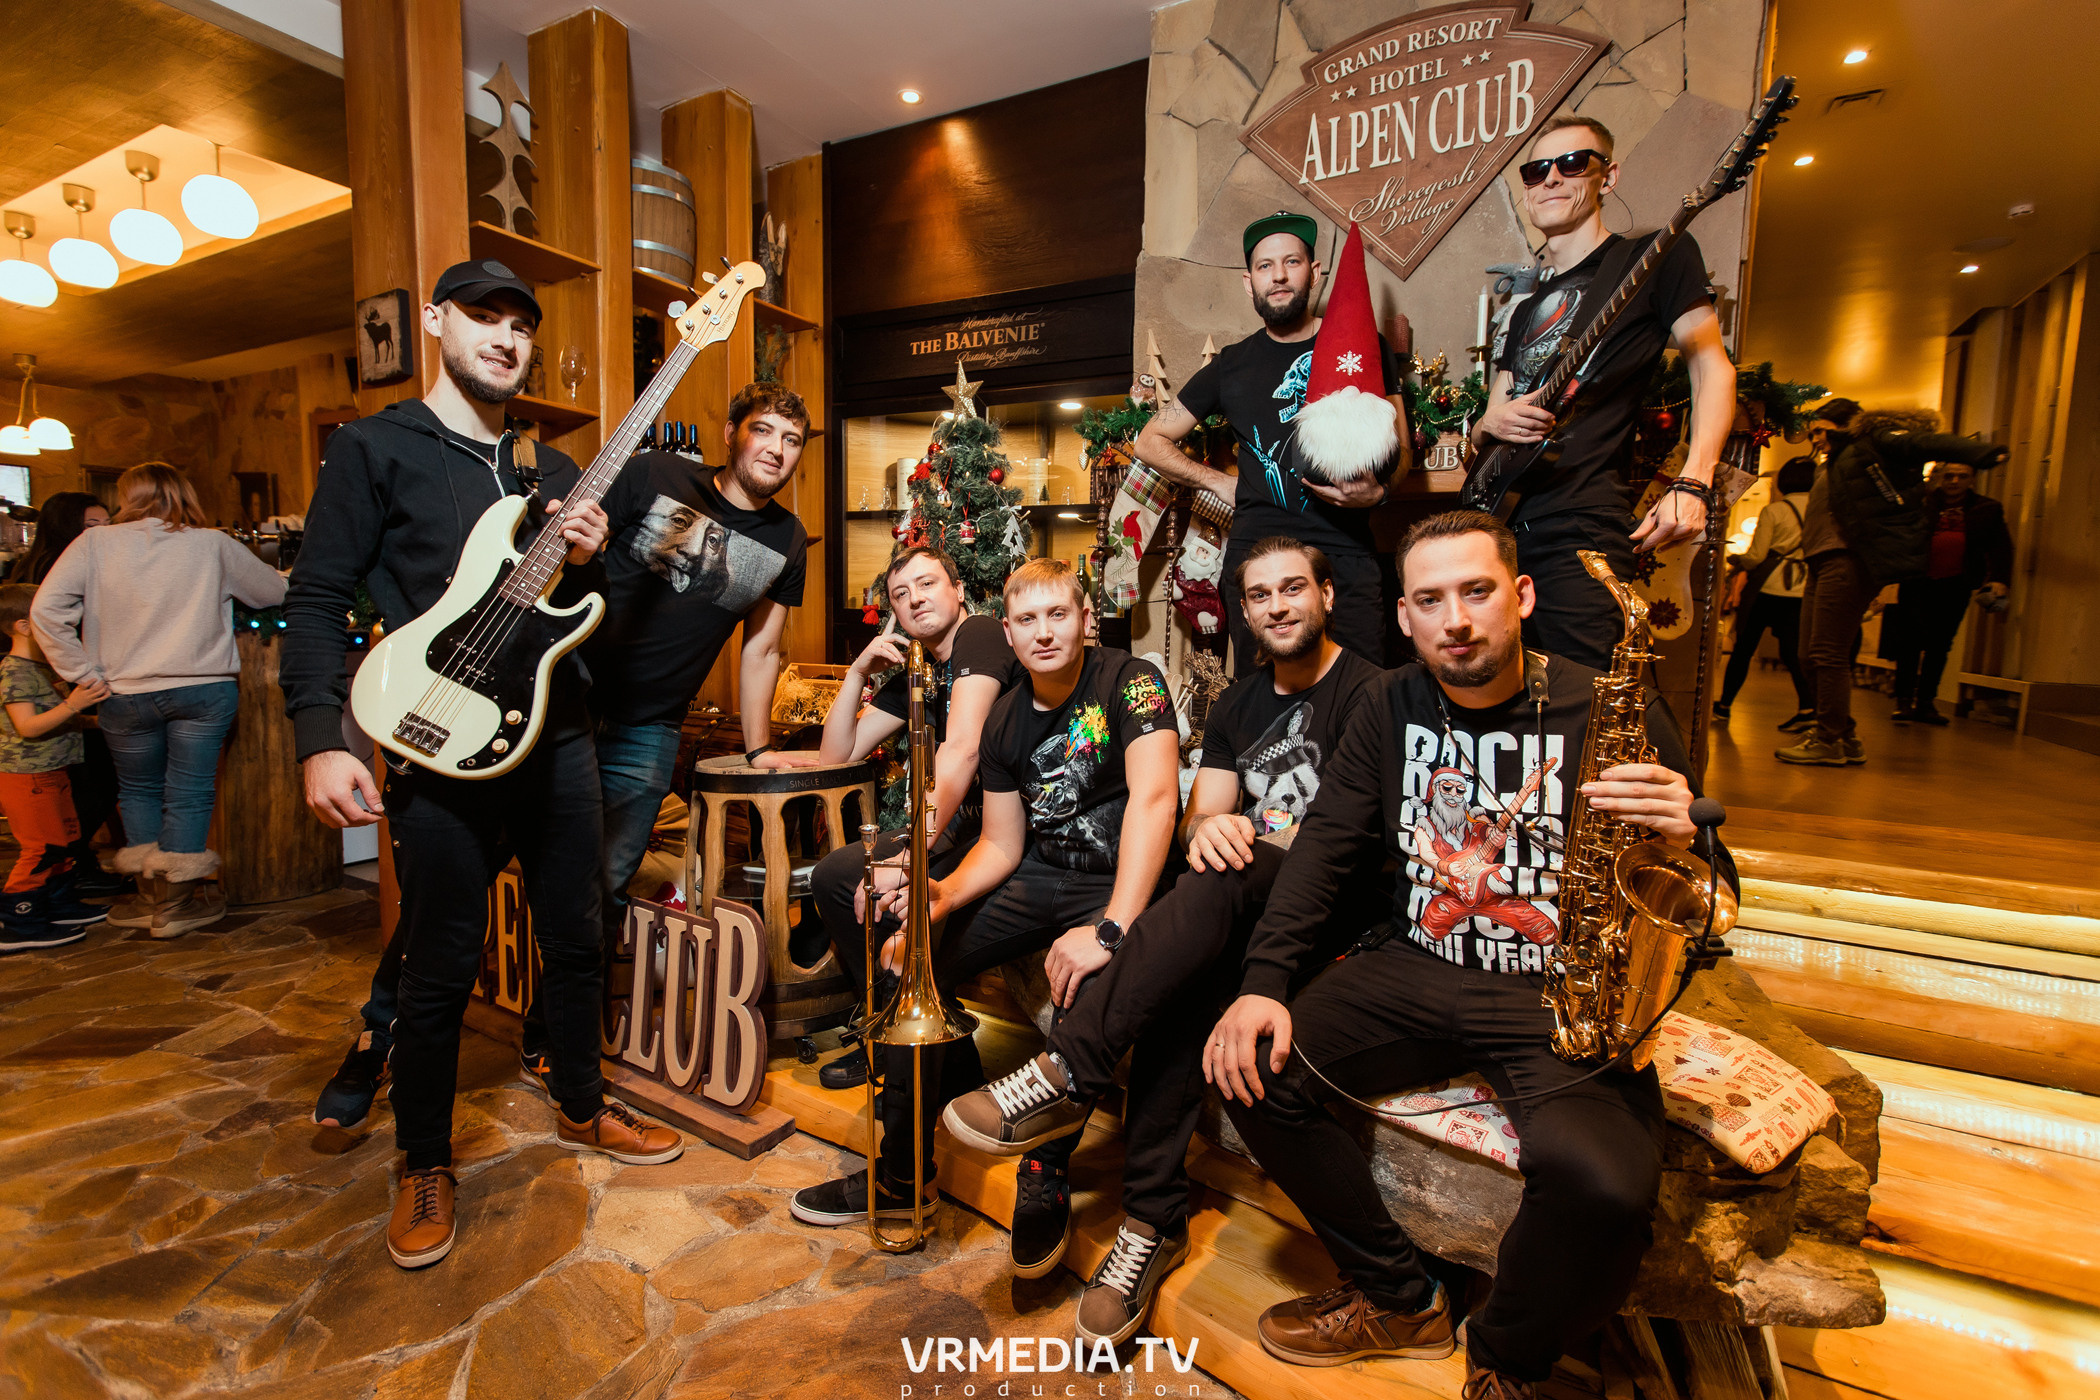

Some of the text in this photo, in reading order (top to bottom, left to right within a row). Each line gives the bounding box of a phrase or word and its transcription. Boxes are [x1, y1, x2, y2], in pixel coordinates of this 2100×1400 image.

[1323, 17, 1502, 85] GRAND RESORT
[1369, 58, 1449, 97] HOTEL
[1298, 57, 1535, 185] ALPEN CLUB
[1349, 144, 1487, 223] Sheregesh
[1379, 197, 1454, 237] Village
[910, 339, 941, 356] THE
[789, 778, 820, 789] SINGLE
[1402, 723, 1564, 815] ROCK
